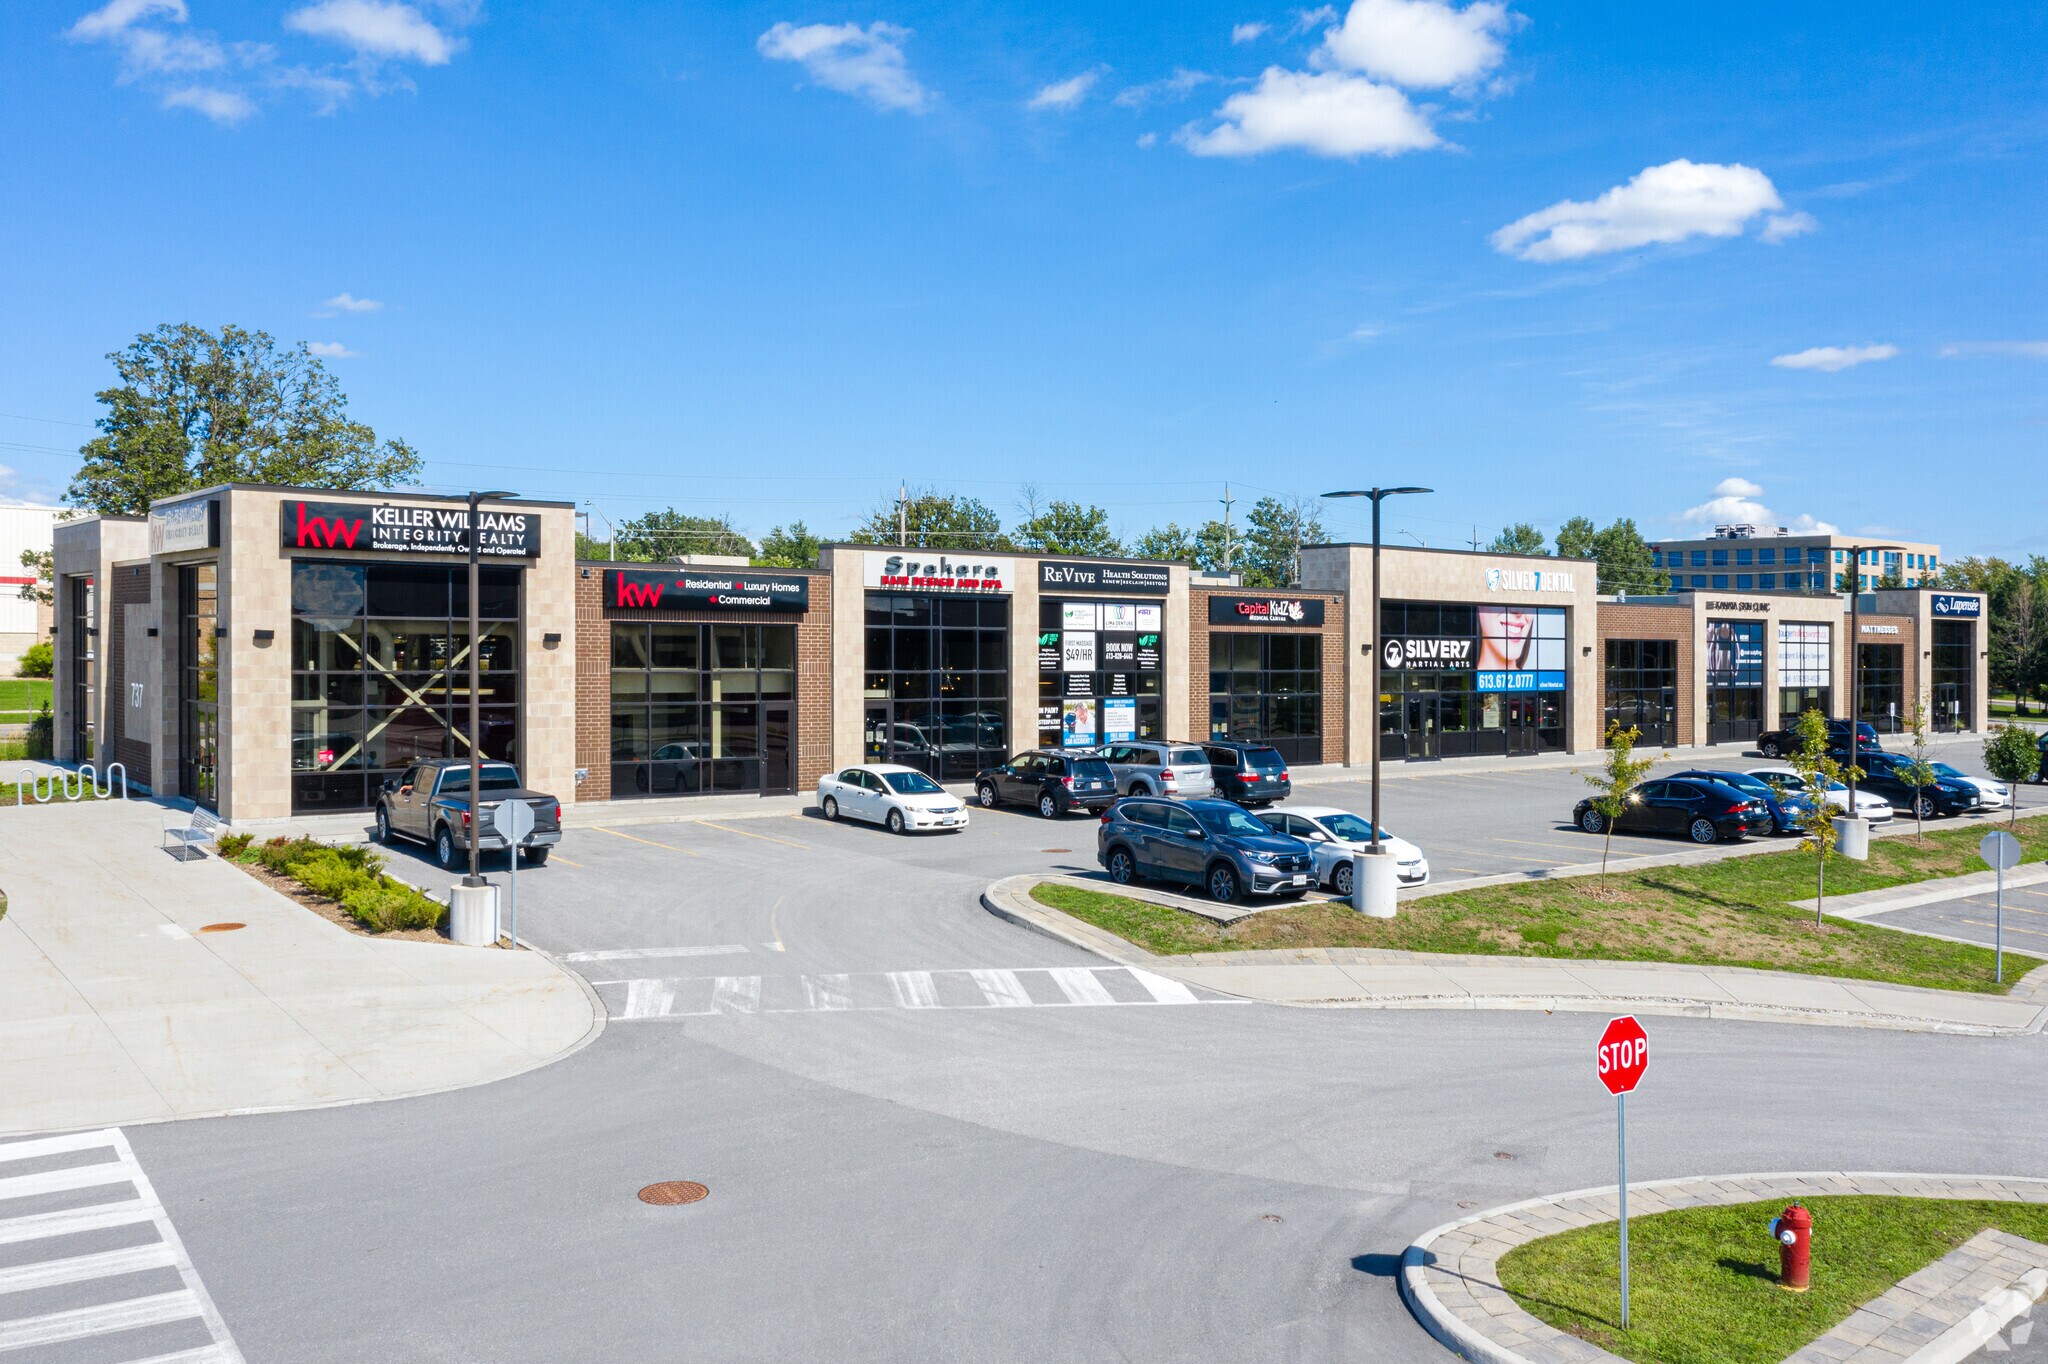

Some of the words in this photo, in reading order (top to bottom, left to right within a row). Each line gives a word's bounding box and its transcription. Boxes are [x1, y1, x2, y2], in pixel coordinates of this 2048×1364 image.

[297, 501, 364, 549] kw
[372, 507, 434, 528] KELLER
[436, 510, 526, 532] WILIAMS
[372, 527, 461, 543] INTEGRITY
[479, 532, 525, 545] EALTY
[372, 541, 409, 552] Brokerage,
[410, 543, 455, 553] Independently
[457, 545, 481, 554] Owd
[482, 546, 494, 554] and
[496, 546, 526, 556] Operated
[884, 555, 999, 580] Spahara
[617, 571, 665, 608] kw
[685, 579, 732, 591] Residential
[743, 581, 770, 594] Luxury
[771, 582, 800, 593] Homes
[880, 575, 910, 587] HAIR
[912, 577, 955, 588] DESIGN
[956, 578, 980, 589] AND
[981, 579, 1003, 590] SPA
[717, 595, 771, 606] Commercial
[1237, 602, 1269, 616] Capital
[1949, 597, 1979, 614] Lapensée
[1861, 625, 1899, 635] MATTRESSES
[1065, 648, 1093, 661] $49/HR
[1105, 642, 1120, 652] BOOK
[1120, 643, 1134, 653] NOW
[1405, 639, 1471, 659] SILVER7
[131, 682, 144, 708] 737
[1599, 1037, 1647, 1074] STOP
